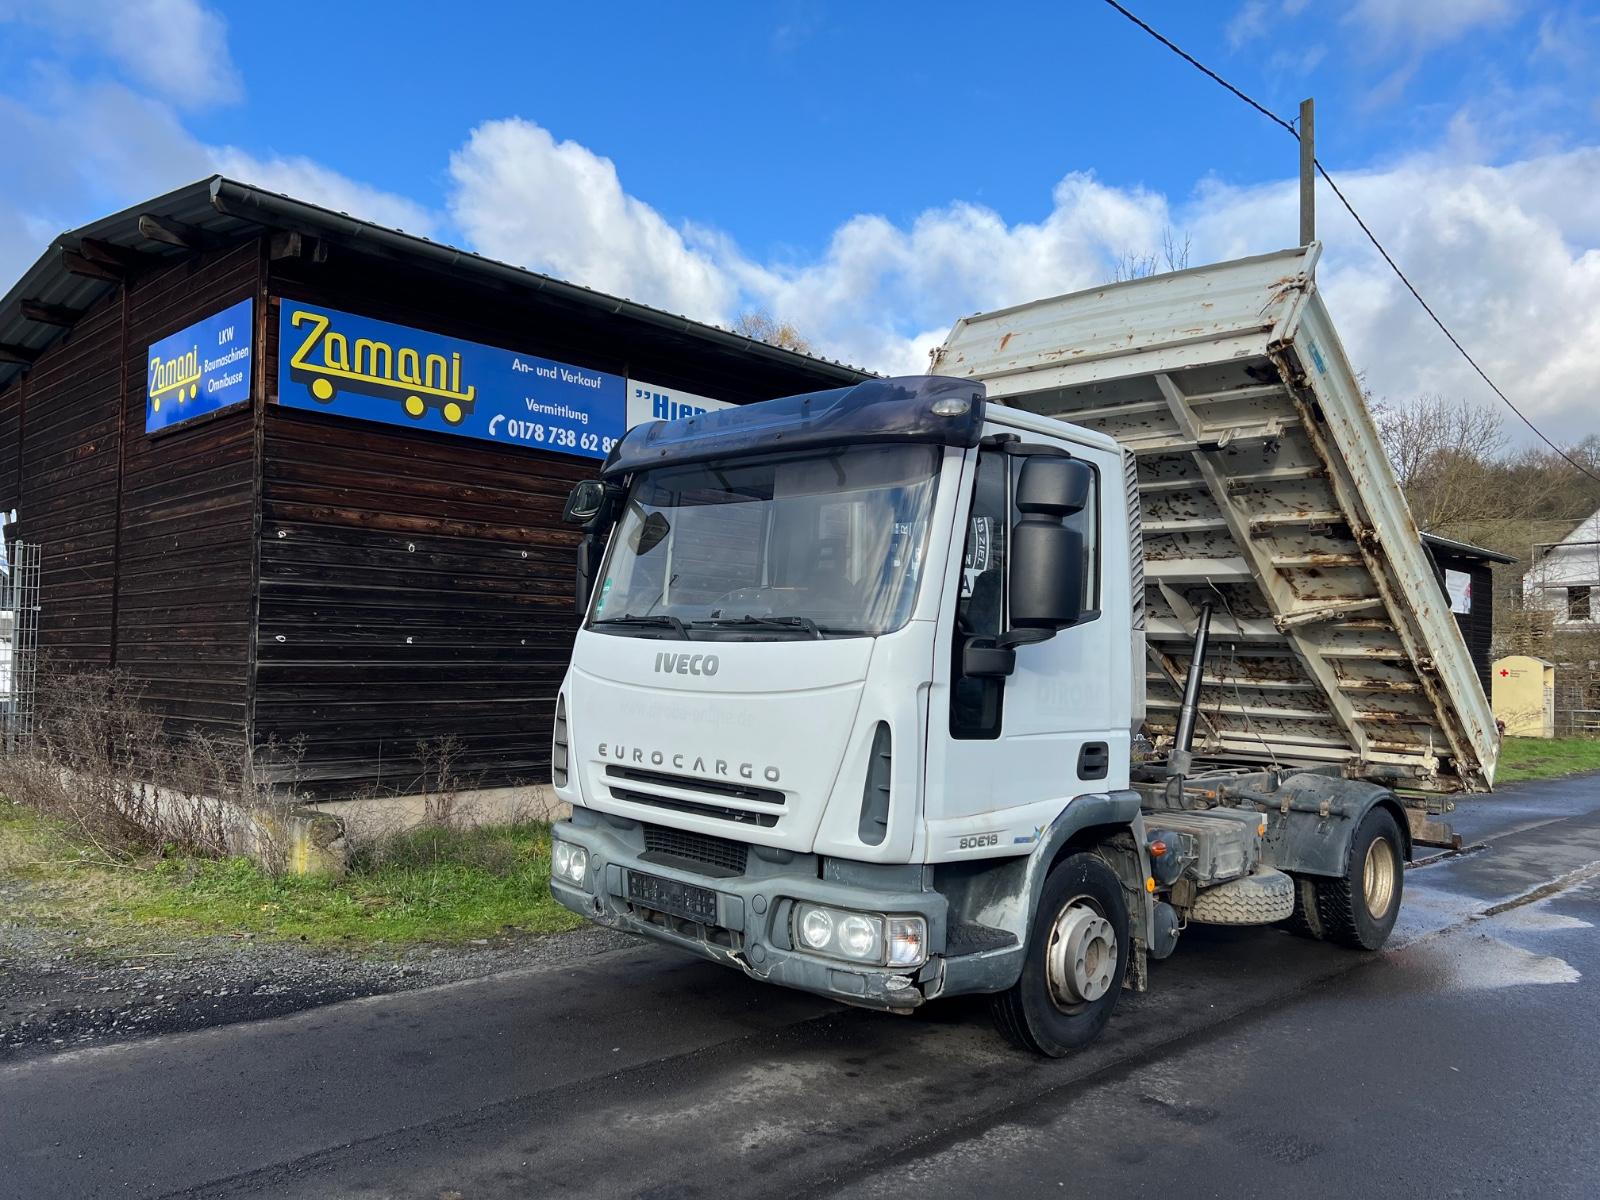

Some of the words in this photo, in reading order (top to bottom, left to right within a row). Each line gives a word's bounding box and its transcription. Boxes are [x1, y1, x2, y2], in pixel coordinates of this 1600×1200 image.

[218, 325, 235, 346] LKW
[204, 346, 249, 373] Baumaschinen
[291, 310, 475, 401] Zamani
[150, 345, 202, 398] Zamani
[207, 371, 243, 393] Omnibusse
[512, 358, 534, 373] An-
[536, 364, 557, 380] und
[560, 368, 602, 389] Verkauf
[525, 397, 589, 425] Vermittlung
[507, 419, 544, 442] 0178
[549, 426, 576, 448] 738
[580, 432, 598, 452] 62
[654, 652, 720, 676] IVECO
[598, 742, 781, 783] EUROCARGO
[959, 834, 998, 849] 80E18
